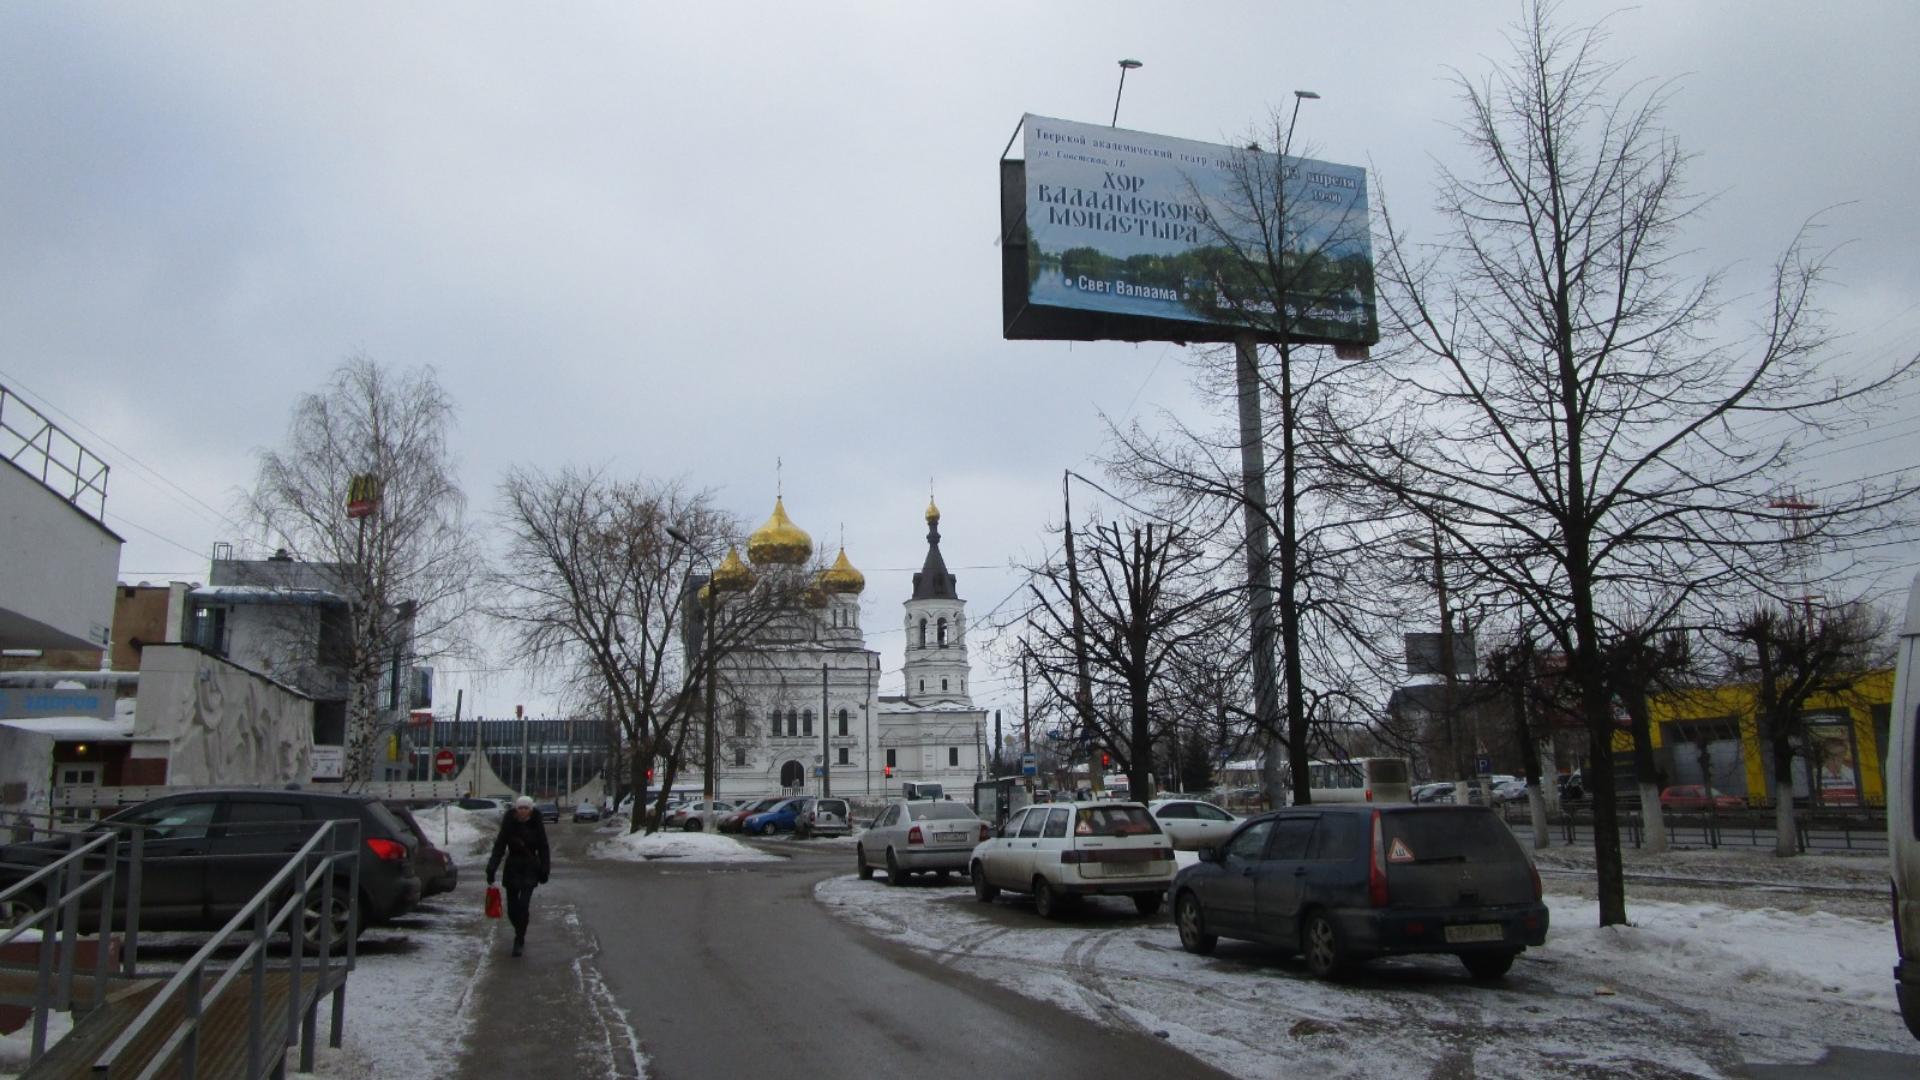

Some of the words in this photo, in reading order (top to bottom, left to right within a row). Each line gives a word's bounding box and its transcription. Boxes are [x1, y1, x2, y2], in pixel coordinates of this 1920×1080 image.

[1036, 128, 1086, 145] Тверской
[1093, 139, 1173, 159] академический
[1180, 154, 1208, 168] театр
[1102, 171, 1145, 193] ХОР
[1306, 172, 1357, 190] апреля
[1038, 184, 1209, 224] ВАЛААМСКОГО
[1049, 206, 1199, 243] МОНАСТЫРЯ
[1078, 275, 1111, 292] Свет
[1116, 280, 1177, 301] Валаама
